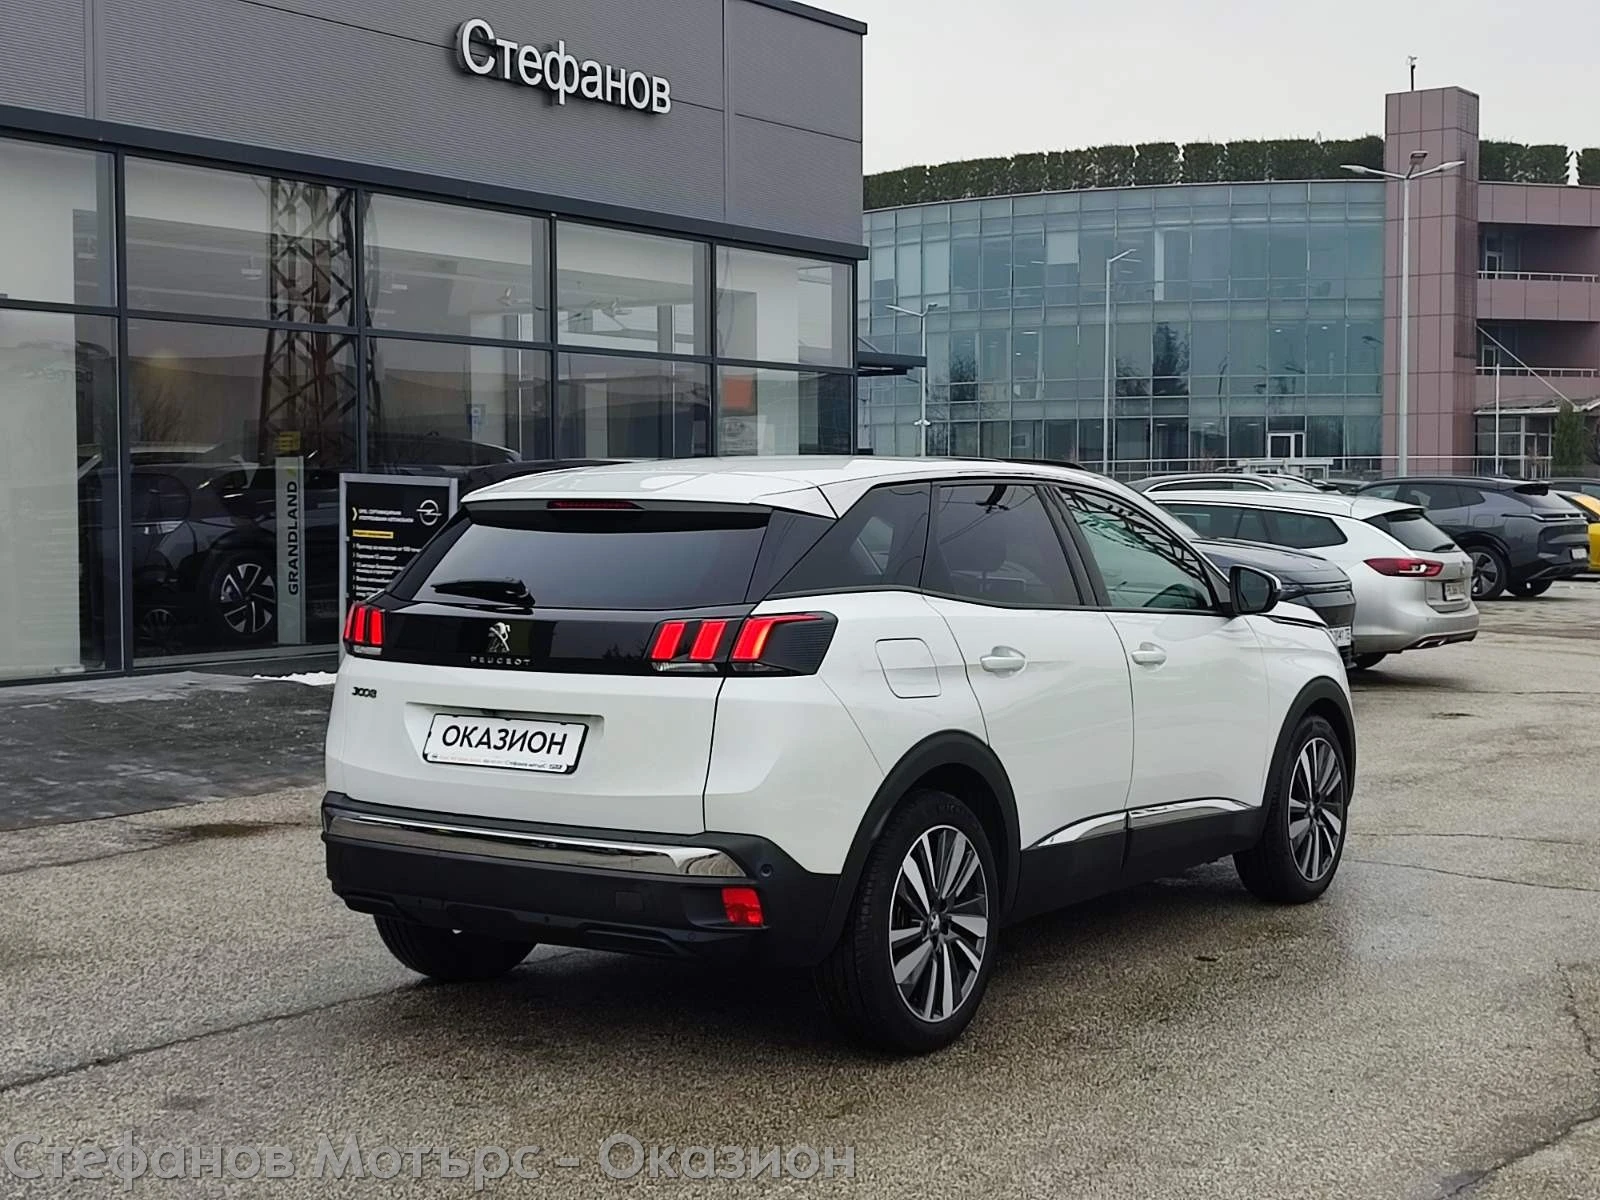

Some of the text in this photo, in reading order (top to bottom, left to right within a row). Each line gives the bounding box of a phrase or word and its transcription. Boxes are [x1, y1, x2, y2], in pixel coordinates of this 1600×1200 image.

[459, 18, 672, 114] Стефанов
[286, 480, 299, 596] GRANDLAND
[470, 655, 531, 666] PEUGEOT
[441, 724, 568, 756] ОКАЗИОН
